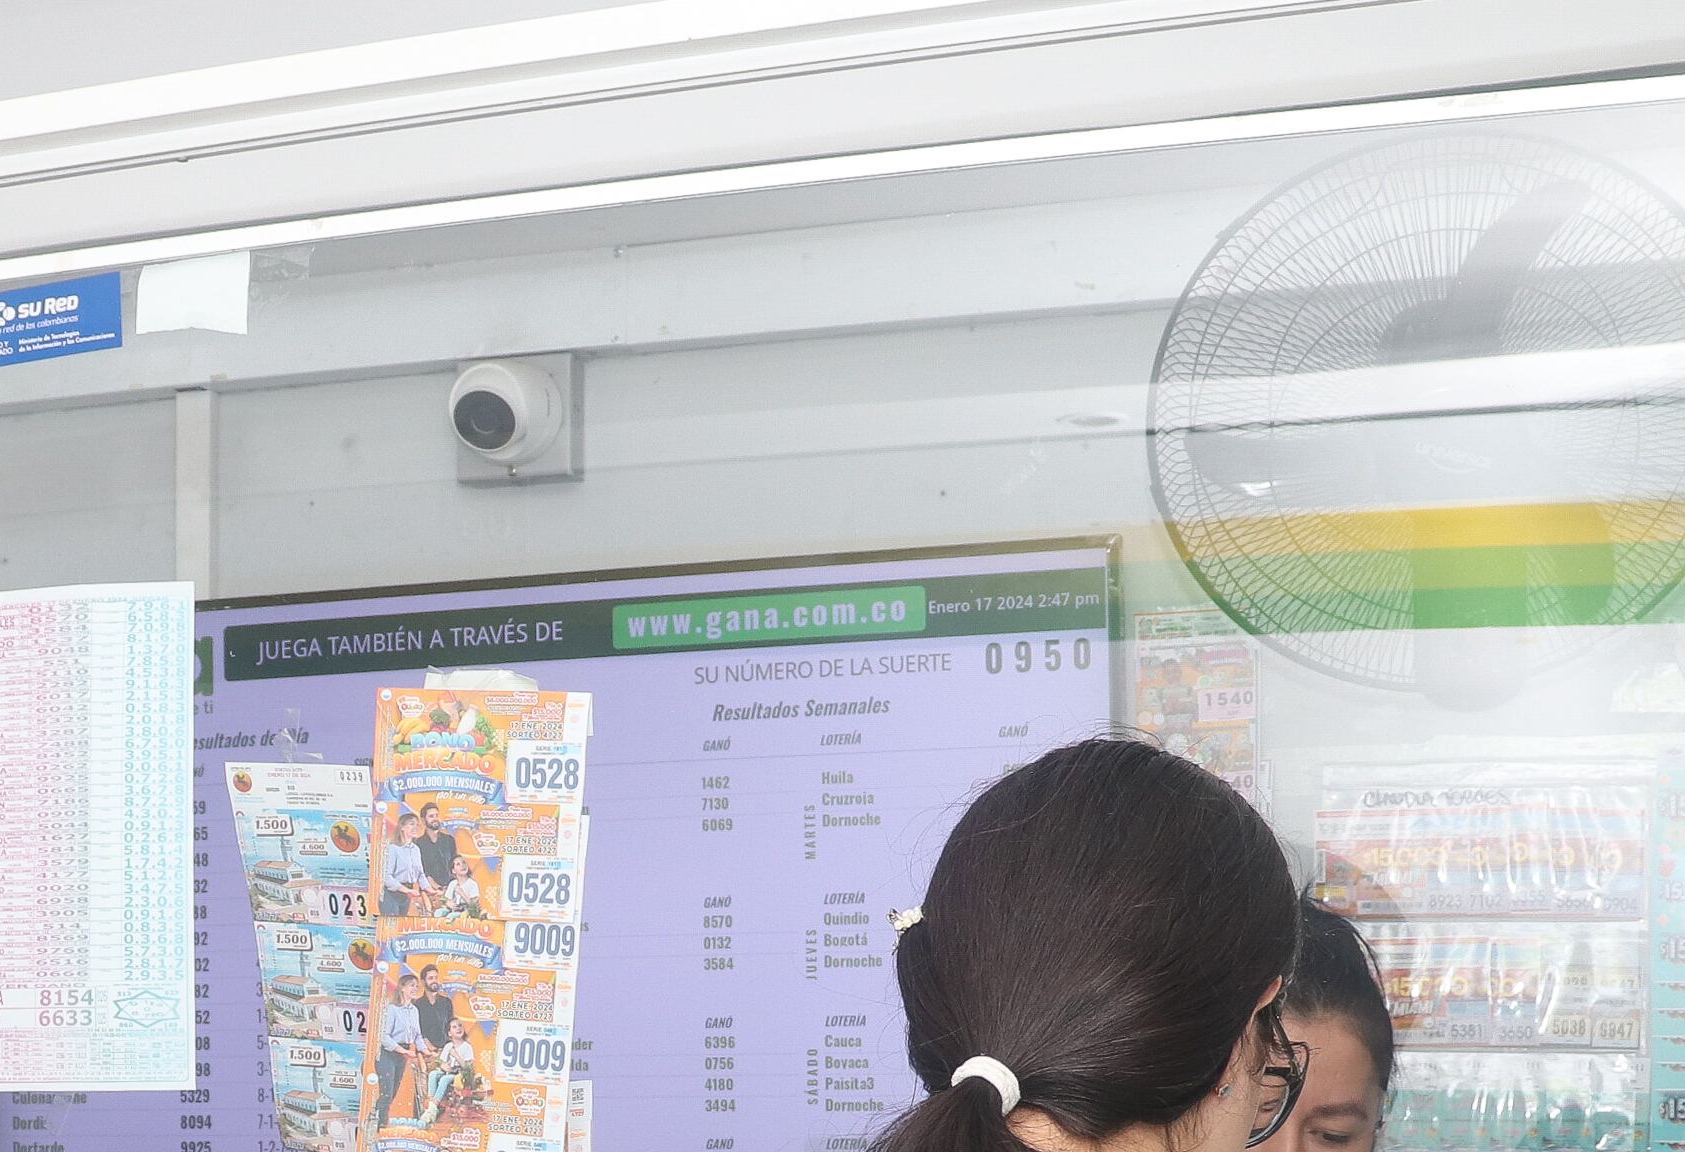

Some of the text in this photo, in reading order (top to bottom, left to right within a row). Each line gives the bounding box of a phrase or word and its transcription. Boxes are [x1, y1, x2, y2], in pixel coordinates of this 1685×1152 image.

[18, 301, 41, 319] SU
[3, 324, 14, 333] red
[16, 323, 24, 332] de
[37, 315, 78, 328] colombianos
[928, 592, 1099, 615] Enero 17 2024 2:47 pm
[627, 597, 907, 638] www.gana.com.co
[257, 619, 563, 664] JUEGA TAMBIÉN A TRAVÉS DE
[694, 652, 952, 685] SU NÚMERO DE LA SUERTE
[1205, 691, 1253, 707] 1540
[712, 696, 890, 723] Resultados Semanales
[999, 724, 1028, 738] GANÓ
[411, 732, 475, 750] BONO
[702, 730, 862, 753] GANÓ LOTERÍA
[394, 752, 494, 773] MERCADO
[339, 771, 364, 782] 0239
[515, 757, 579, 790] 0528
[701, 770, 854, 790] 1462 Huila
[392, 776, 496, 794] $2.000.000 MENSUALES
[702, 797, 729, 811] 7130
[255, 819, 288, 829] 1.500
[702, 813, 881, 832] 6069 Dornoche
[804, 803, 816, 860] MARTES
[508, 872, 571, 904] 0528
[704, 892, 866, 909] GANÓ LOTERÍA
[398, 918, 493, 936] MERCADO
[703, 915, 733, 928] 8570
[276, 934, 308, 944] 1.500
[514, 922, 575, 957] 9009
[704, 933, 868, 949] 0132 Bogotá
[395, 938, 493, 958] $2.000.000 MENSUALES
[806, 928, 817, 980] JUEVES
[704, 954, 883, 971] 3584 Dornoche
[39, 990, 94, 1006] 8154
[38, 1010, 93, 1026] 6633
[497, 1009, 531, 1019] SORTEO
[705, 1014, 866, 1029] GANÓ LOTERÍA
[704, 1034, 862, 1049] 6396 Cauca
[289, 1049, 321, 1061] 1.500
[503, 1036, 564, 1072] 9009
[705, 1056, 734, 1070] 0756
[705, 1076, 875, 1091] 4180 Paisita3
[804, 1048, 819, 1105] SÁBADO
[180, 1088, 210, 1104] 5329
[705, 1098, 884, 1113] 3494 Dornoche
[180, 1114, 212, 1130] 8094
[706, 1137, 734, 1150] GANÓ
